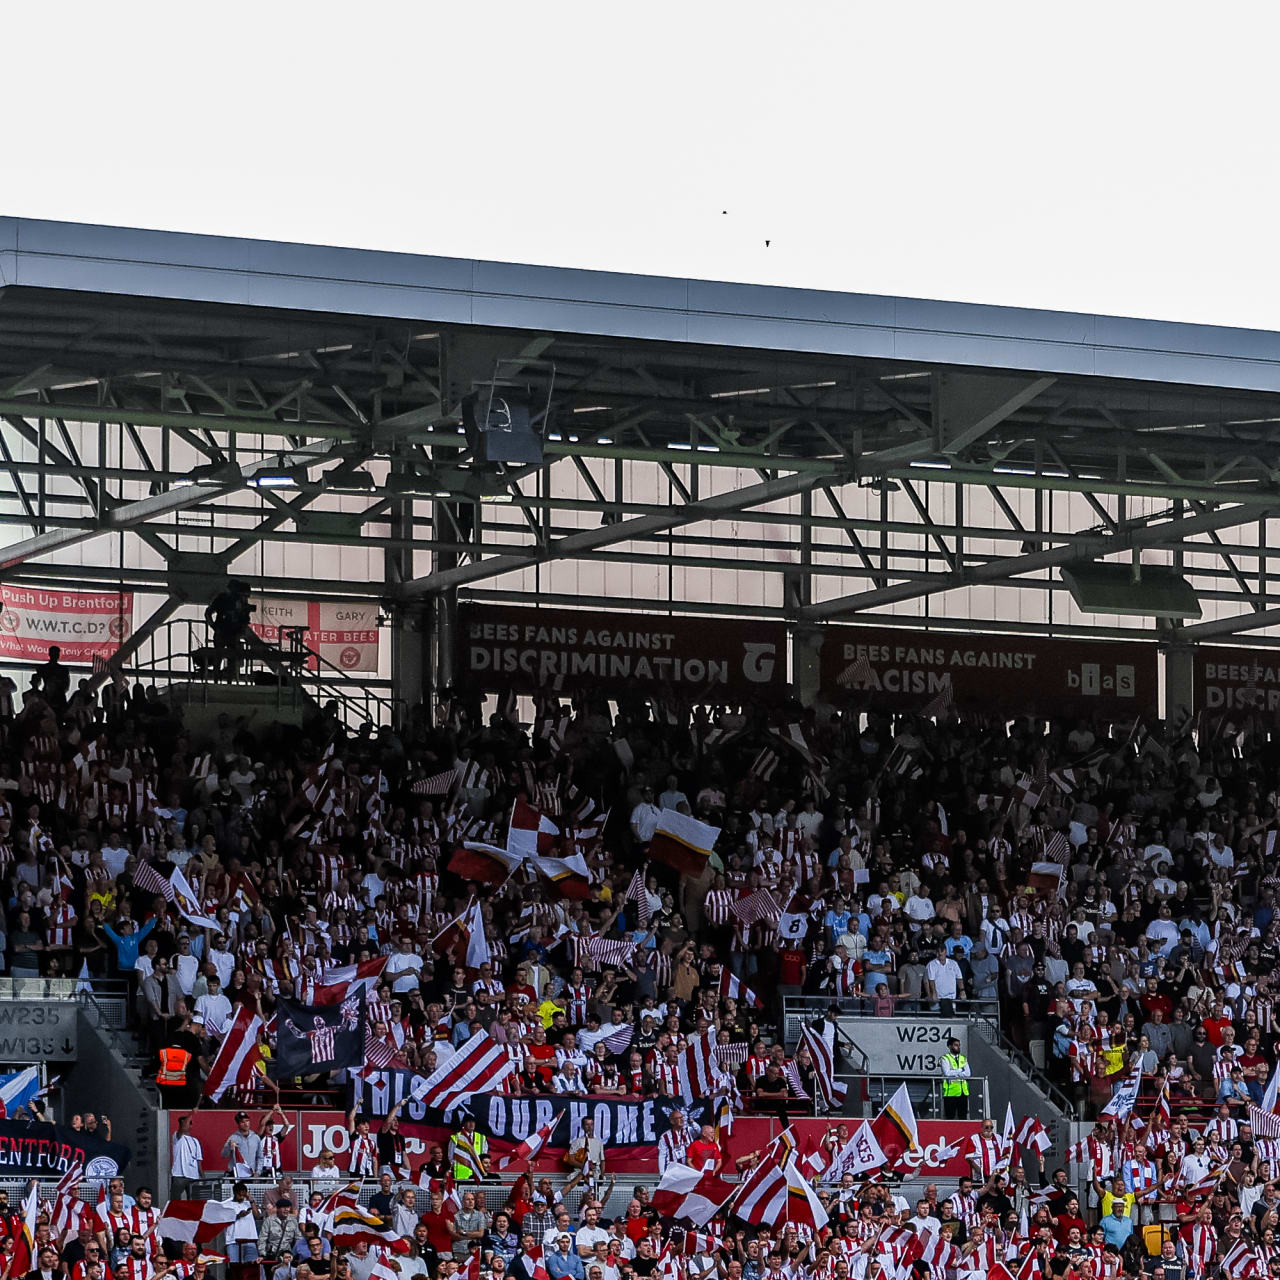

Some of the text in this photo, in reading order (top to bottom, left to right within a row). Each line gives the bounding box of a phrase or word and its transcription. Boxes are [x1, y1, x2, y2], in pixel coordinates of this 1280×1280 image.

[2, 590, 128, 609] Push Up Brentford
[263, 606, 293, 617] KEITH
[336, 611, 366, 621] GARY
[25, 617, 105, 634] W.W.T.C.D?
[343, 632, 376, 641] BEES
[469, 623, 676, 650] BEES FANS AGAINST
[470, 646, 728, 684] DISCRIMINATION
[844, 644, 1036, 669] BEES FANS AGAINST
[1205, 664, 1249, 681] BEES
[789, 919, 801, 933] 8
[0, 1007, 59, 1025] W235
[897, 1026, 952, 1042] W234
[0, 1037, 55, 1055] W135
[488, 1096, 555, 1141] OUR
[570, 1101, 656, 1144] HOME
